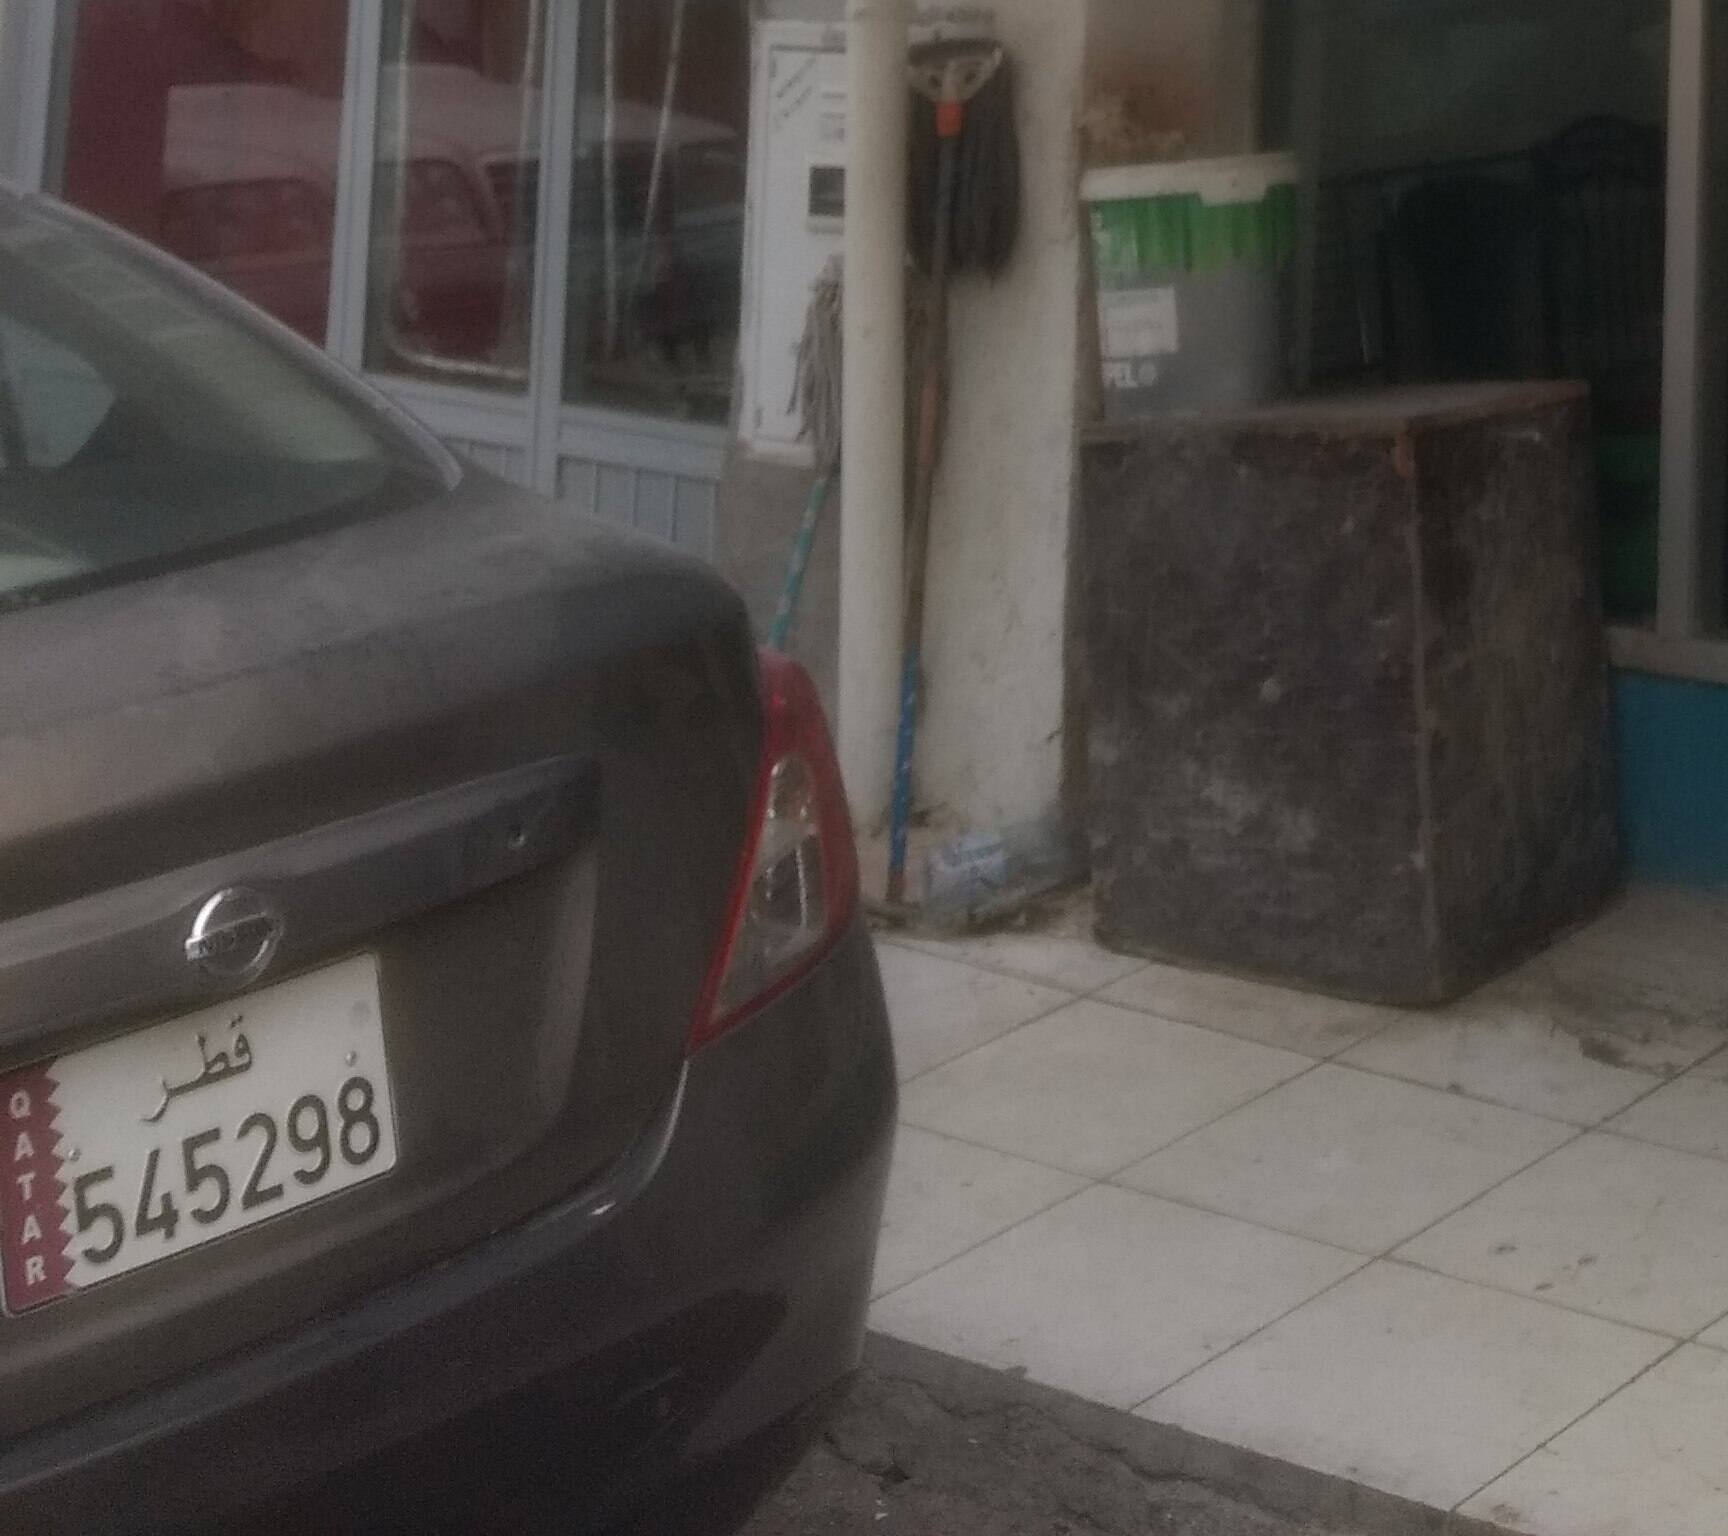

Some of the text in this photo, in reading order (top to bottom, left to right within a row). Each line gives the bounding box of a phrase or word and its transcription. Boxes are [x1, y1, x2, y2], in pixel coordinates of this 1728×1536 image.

[140, 1013, 253, 1123] قطر
[9, 1089, 47, 1287] QATAR
[72, 1075, 381, 1265] 545298
